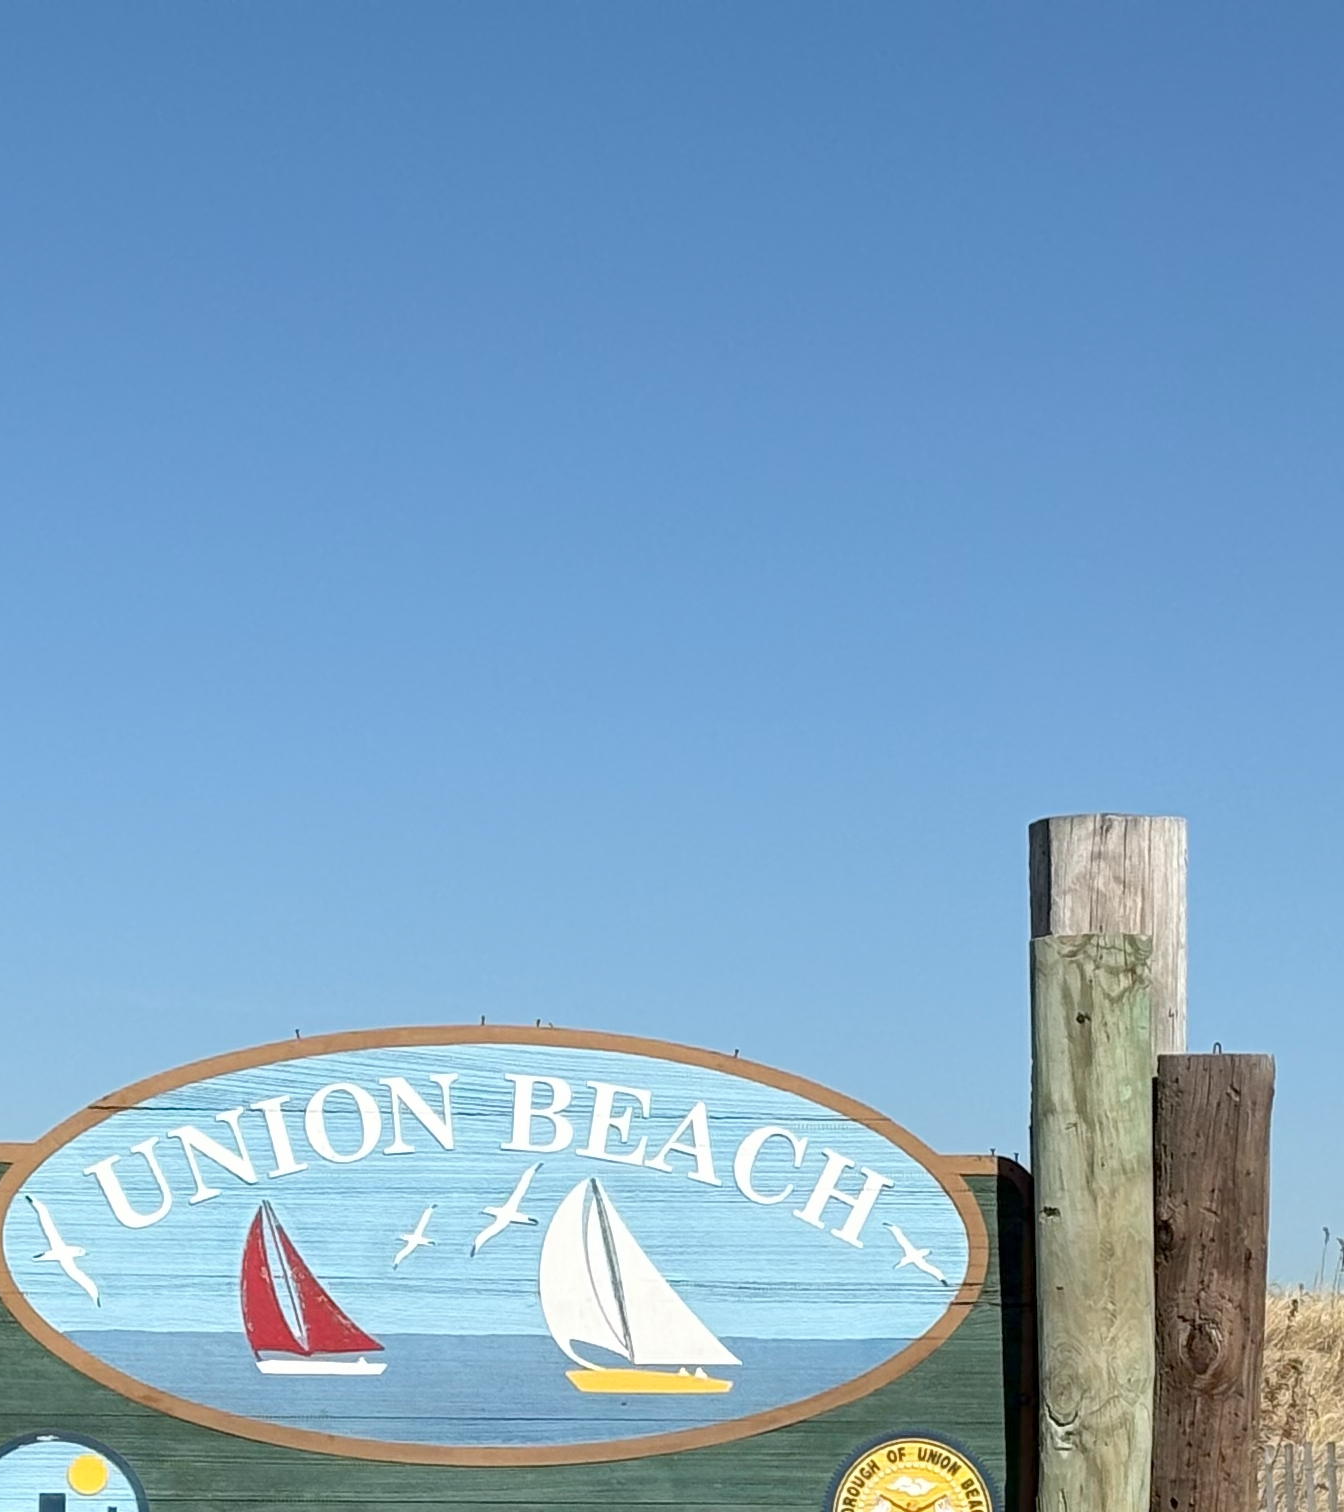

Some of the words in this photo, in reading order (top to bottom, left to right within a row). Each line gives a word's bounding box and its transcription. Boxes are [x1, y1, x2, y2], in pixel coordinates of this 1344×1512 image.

[83, 1073, 458, 1228] UNION
[500, 1073, 895, 1249] BEACH
[886, 1447, 906, 1464] OF
[917, 1446, 962, 1477] UNION
